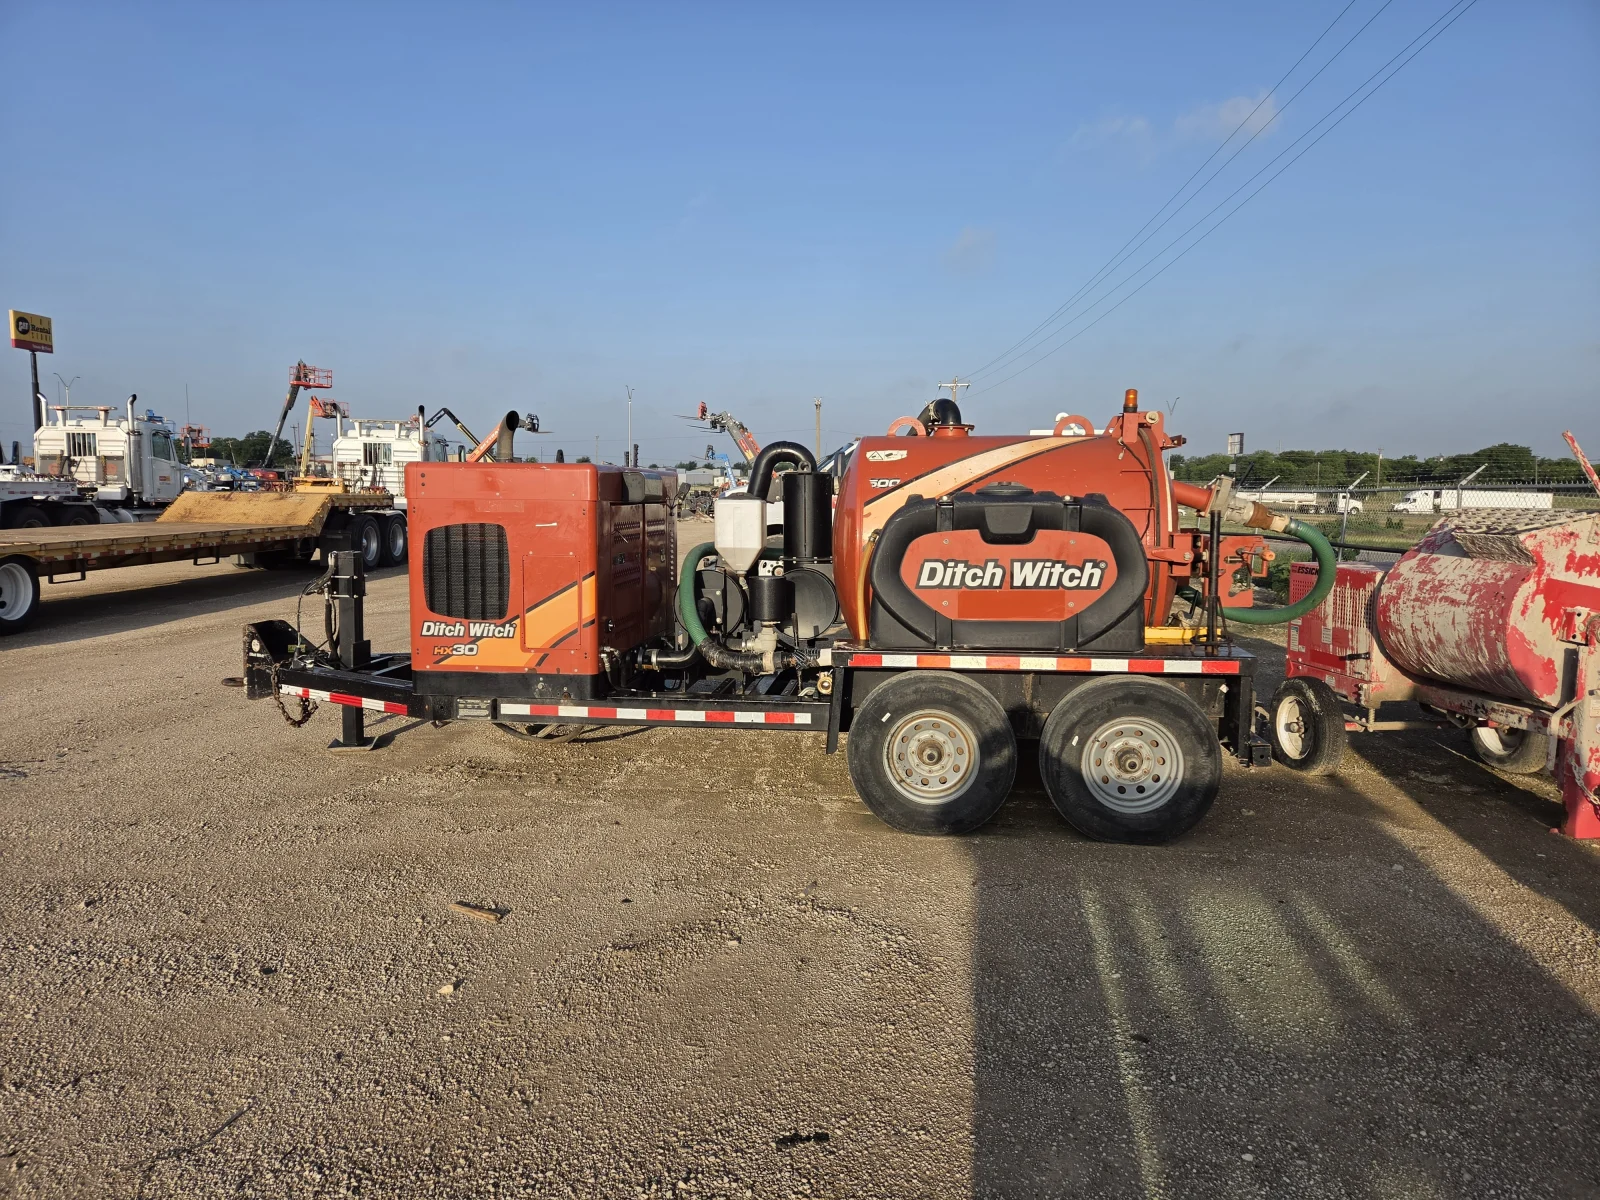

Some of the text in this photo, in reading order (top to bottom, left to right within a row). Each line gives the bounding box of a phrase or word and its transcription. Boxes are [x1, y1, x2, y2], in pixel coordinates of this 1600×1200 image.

[917, 561, 1103, 588] Ditch Witch
[421, 621, 515, 638] Ditch Witch
[433, 643, 478, 655] HX30
